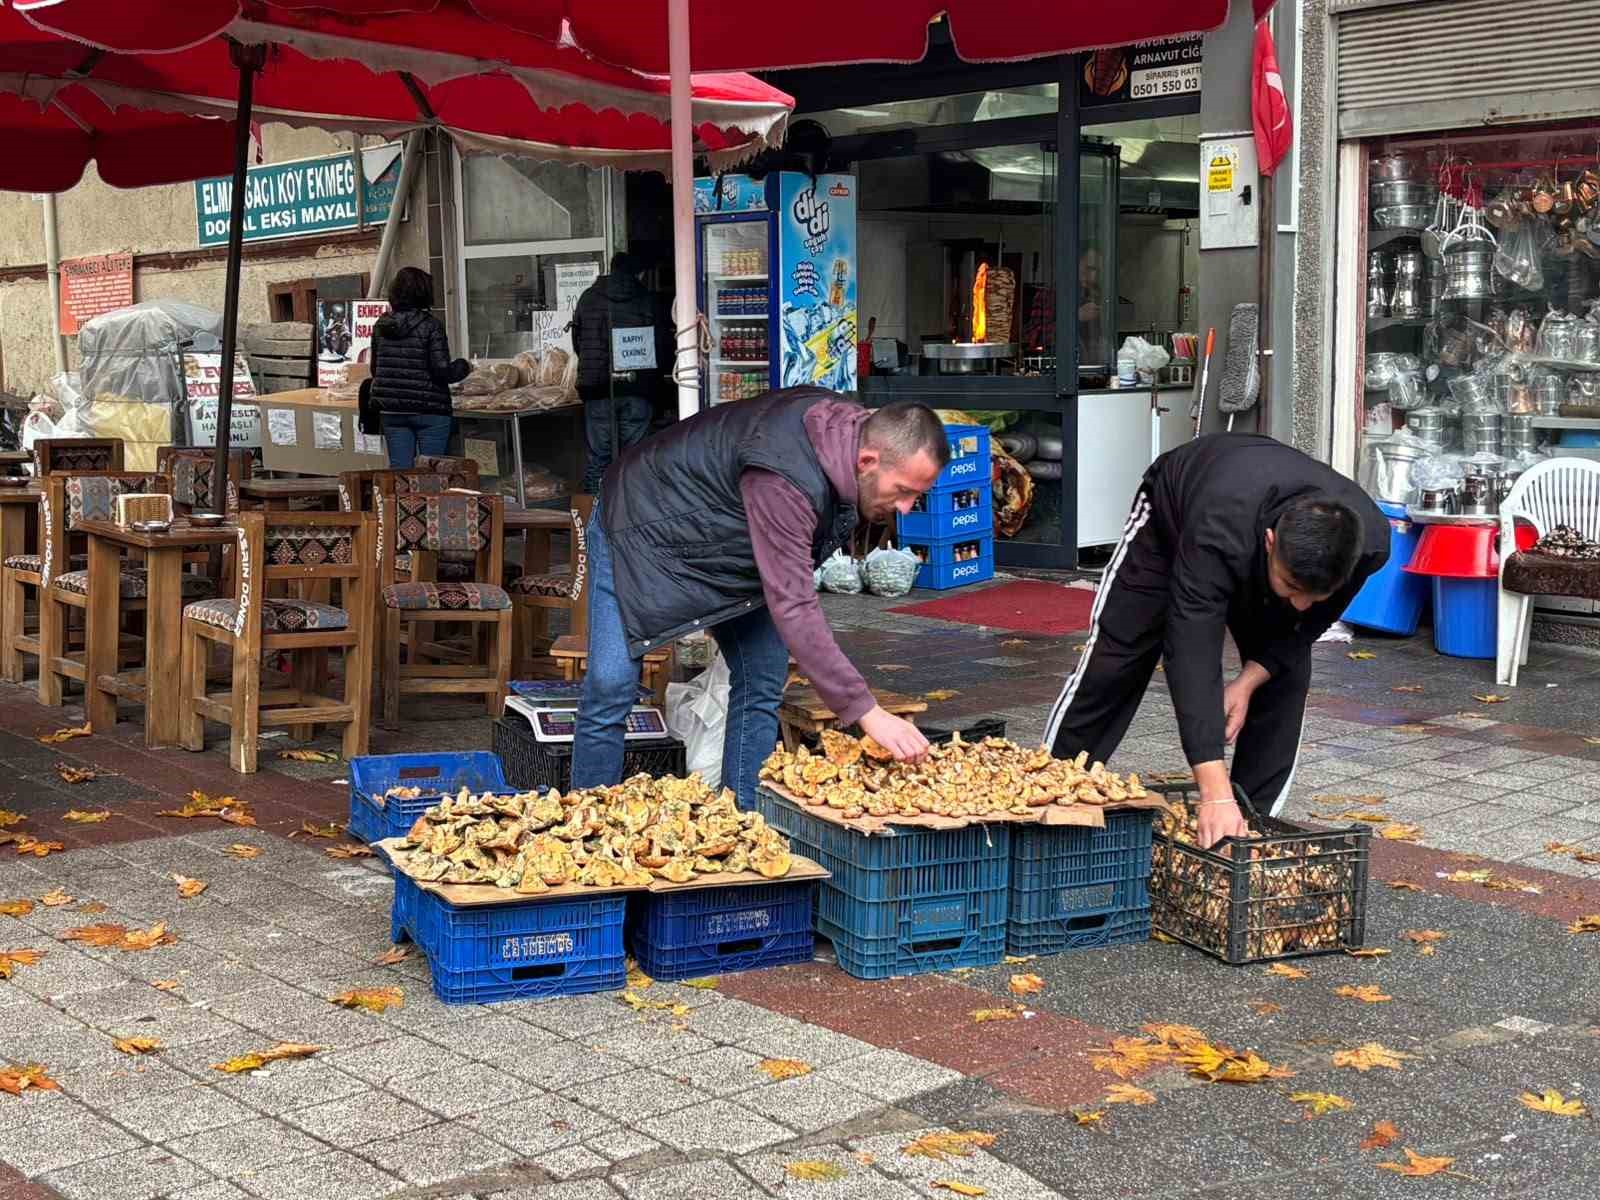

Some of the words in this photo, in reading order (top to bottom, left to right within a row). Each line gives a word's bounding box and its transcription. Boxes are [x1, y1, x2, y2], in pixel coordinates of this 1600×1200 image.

[1134, 49, 1181, 65] ARNAVUT
[1133, 83, 1158, 96] 0501
[1162, 80, 1182, 92] 550
[1184, 77, 1198, 90] 03
[278, 167, 303, 205] KÖY
[307, 159, 356, 201] EKMEĞ
[951, 460, 976, 477] pepsi
[571, 508, 586, 552] ASRIN
[952, 511, 978, 528] pepsi
[237, 527, 250, 579] ASRIN
[570, 553, 588, 601] DÖNER
[953, 562, 979, 579] pepsi
[233, 582, 251, 639] DÖNER
